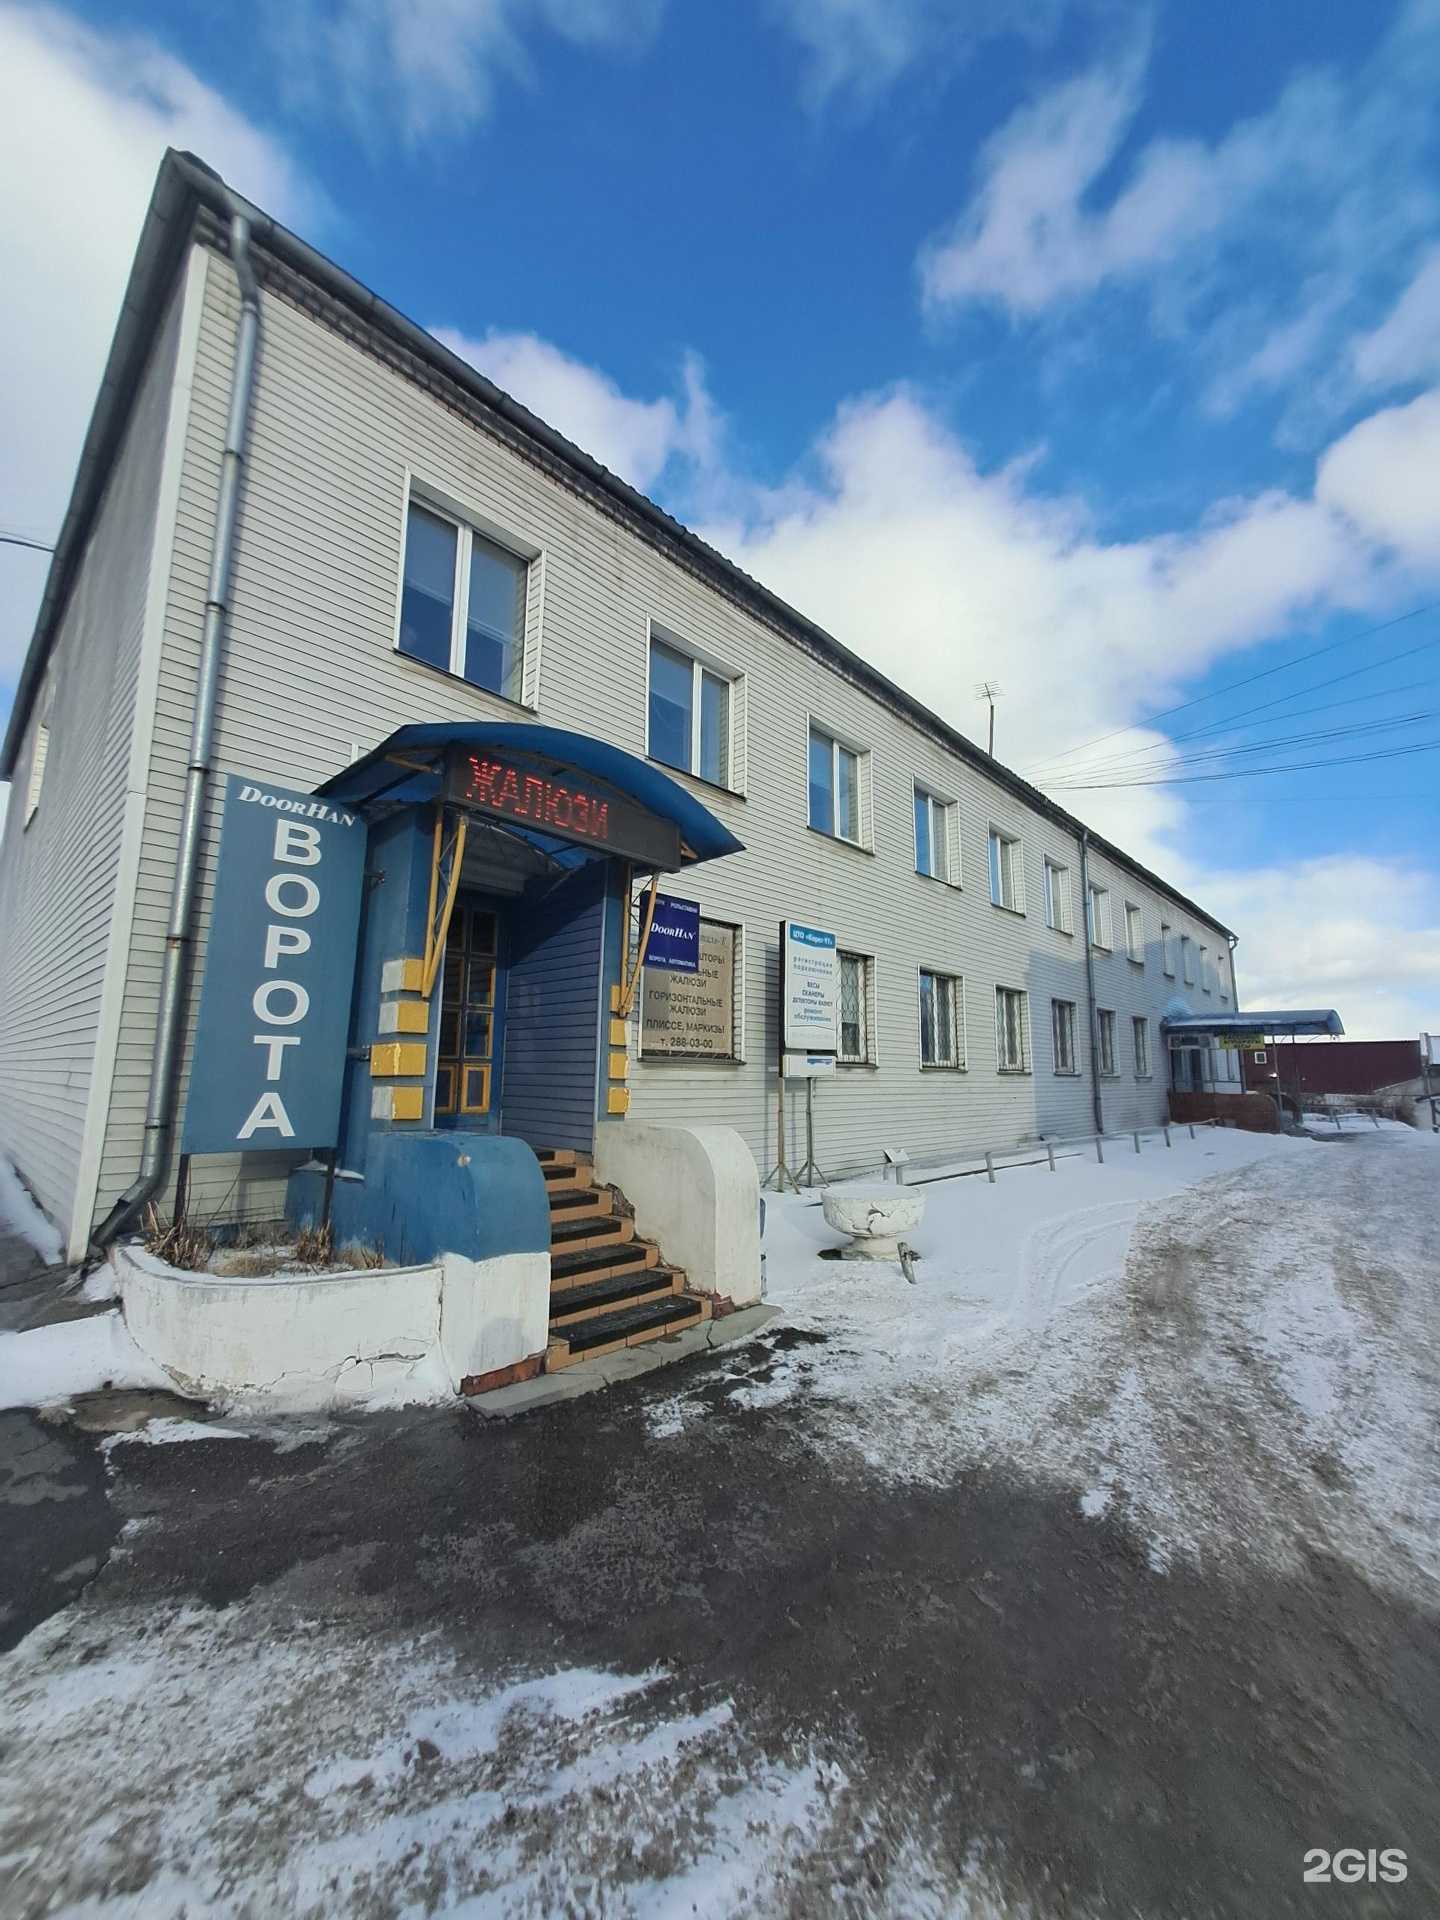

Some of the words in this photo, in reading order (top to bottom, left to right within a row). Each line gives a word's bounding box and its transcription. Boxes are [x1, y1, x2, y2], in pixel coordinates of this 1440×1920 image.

[466, 757, 608, 839] ЖАЛЮЗИ
[236, 818, 322, 1139] ВОРОТА
[670, 975, 707, 988] ЖАЛЮЗИ
[649, 990, 724, 1008] ГОРИЗОНТАЛЬНЫЕ
[670, 1005, 707, 1016] ЖАЛЮЗИ
[686, 1022, 725, 1034] МАРКИЗЫ
[671, 1037, 713, 1048] 288-03-00
